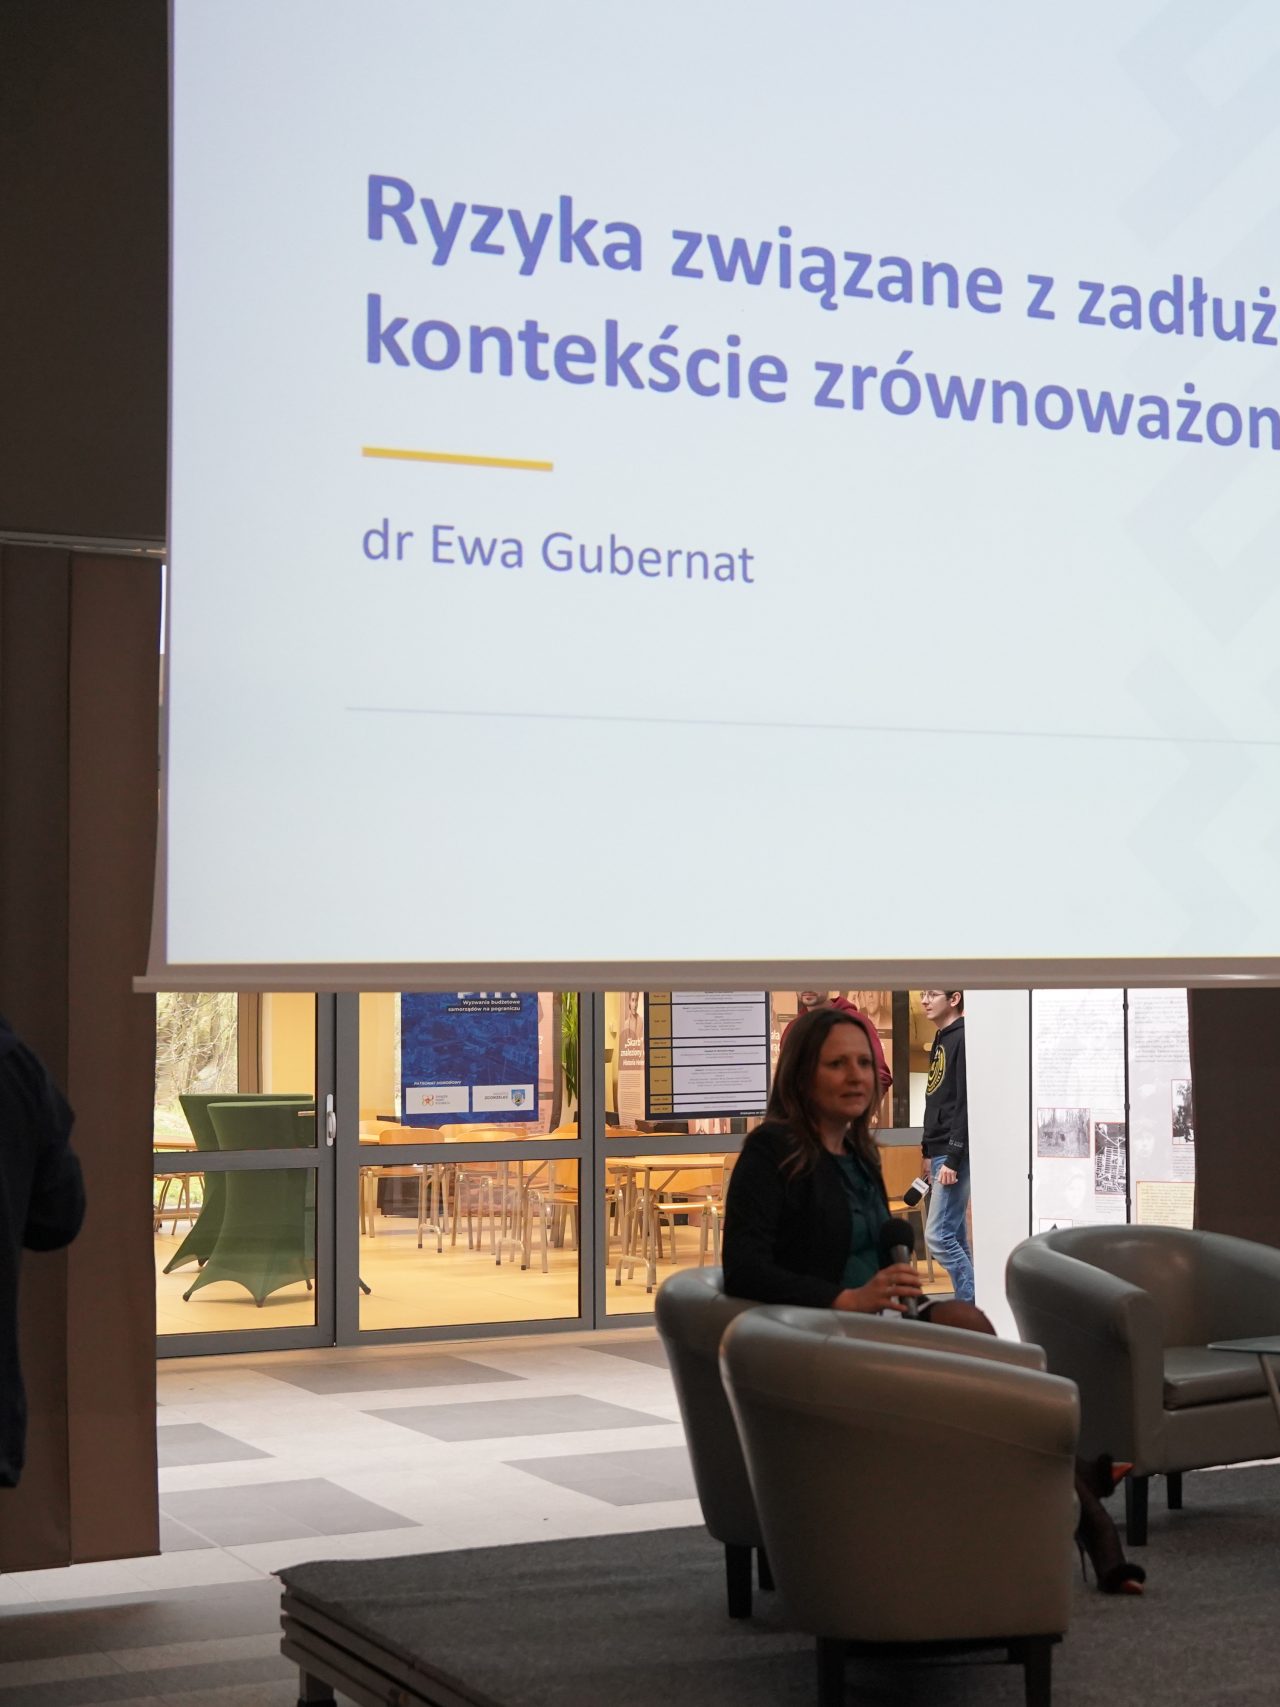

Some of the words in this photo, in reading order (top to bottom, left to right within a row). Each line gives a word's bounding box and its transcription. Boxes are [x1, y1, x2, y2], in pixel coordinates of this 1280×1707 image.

[367, 174, 642, 276] Ryzyka
[671, 225, 1003, 315] związane
[1027, 273, 1056, 321] z
[367, 293, 789, 404] kontekście
[362, 518, 414, 561] dr
[432, 525, 524, 569] Ewa
[541, 532, 755, 584] Gubernat
